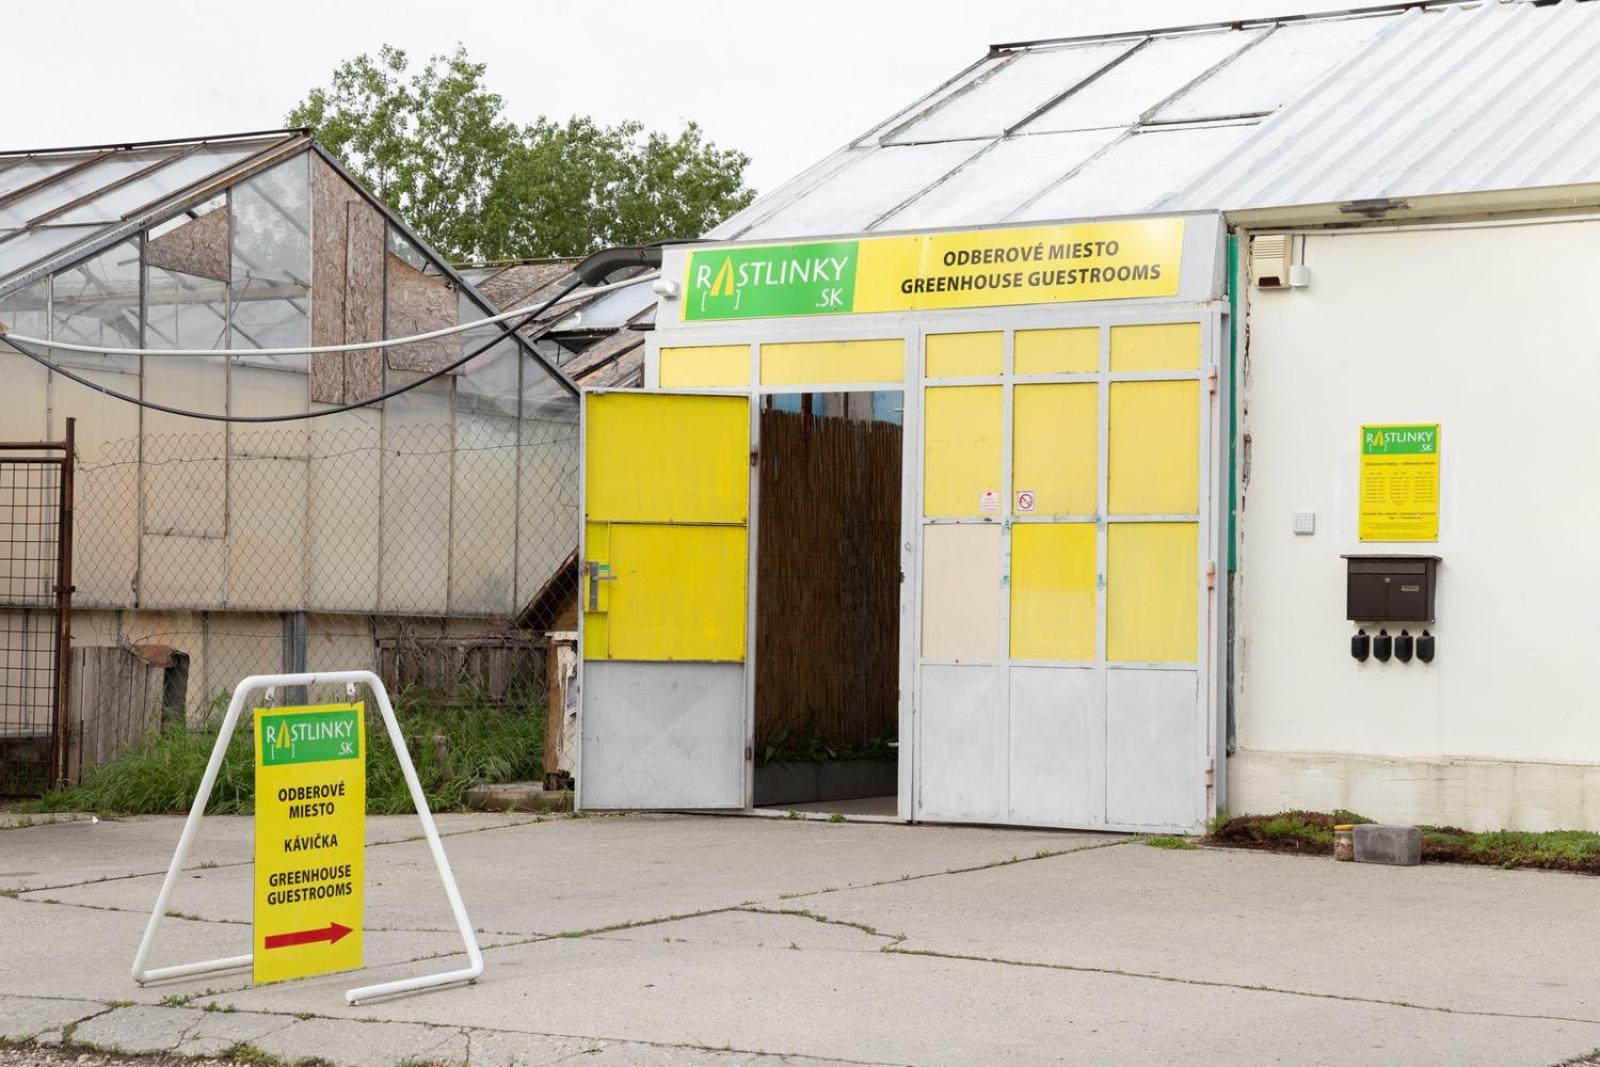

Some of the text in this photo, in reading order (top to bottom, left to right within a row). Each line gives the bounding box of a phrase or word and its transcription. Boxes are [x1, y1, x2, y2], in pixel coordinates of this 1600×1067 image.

[943, 240, 1120, 267] ODBEROVÉ MIESTO
[696, 256, 849, 296] RASTLINKY
[901, 264, 1162, 294] GREENHOUSE GUESTROOMS
[266, 719, 354, 749] RASTLINKY
[278, 780, 346, 802] ODBEROVÉ
[289, 802, 336, 819] MIESTO
[284, 833, 338, 852] KÁVIČKA
[269, 864, 352, 887] GREENHOUSE
[267, 882, 353, 905] GUESTROOMS
